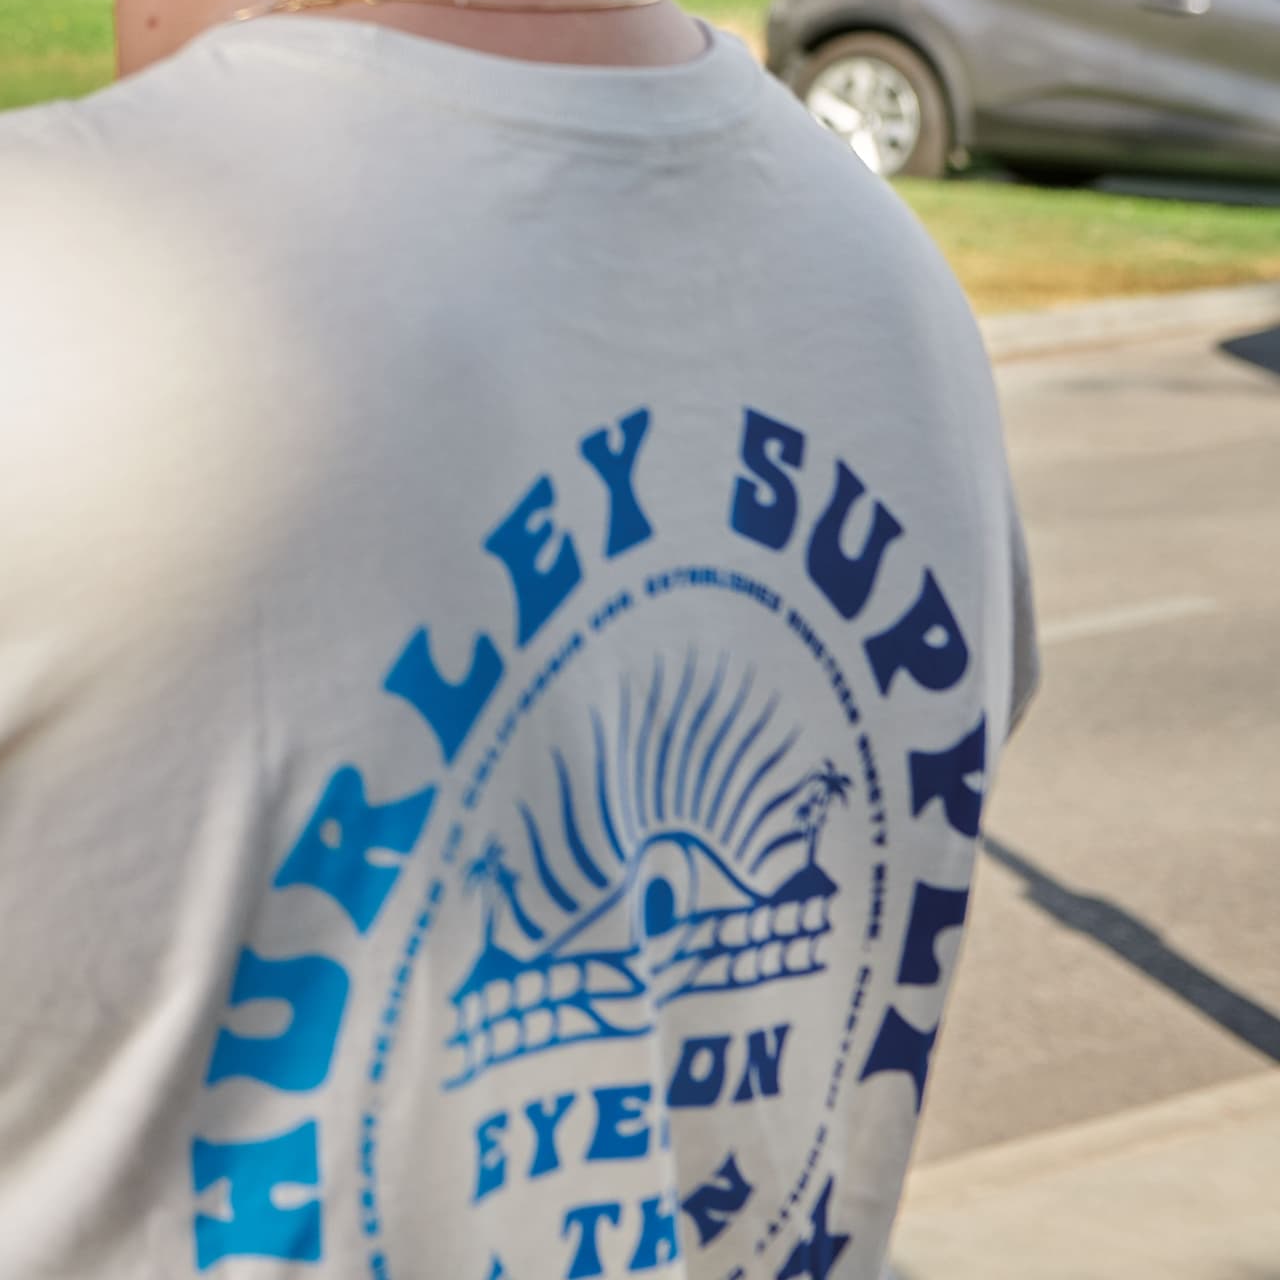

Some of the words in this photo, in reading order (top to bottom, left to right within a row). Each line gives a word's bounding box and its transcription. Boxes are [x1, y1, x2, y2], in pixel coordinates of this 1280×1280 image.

[189, 405, 656, 1275] HURLEY
[471, 1081, 670, 1207] EYE
[662, 1022, 790, 1110] ON
[560, 1190, 679, 1280] TH
